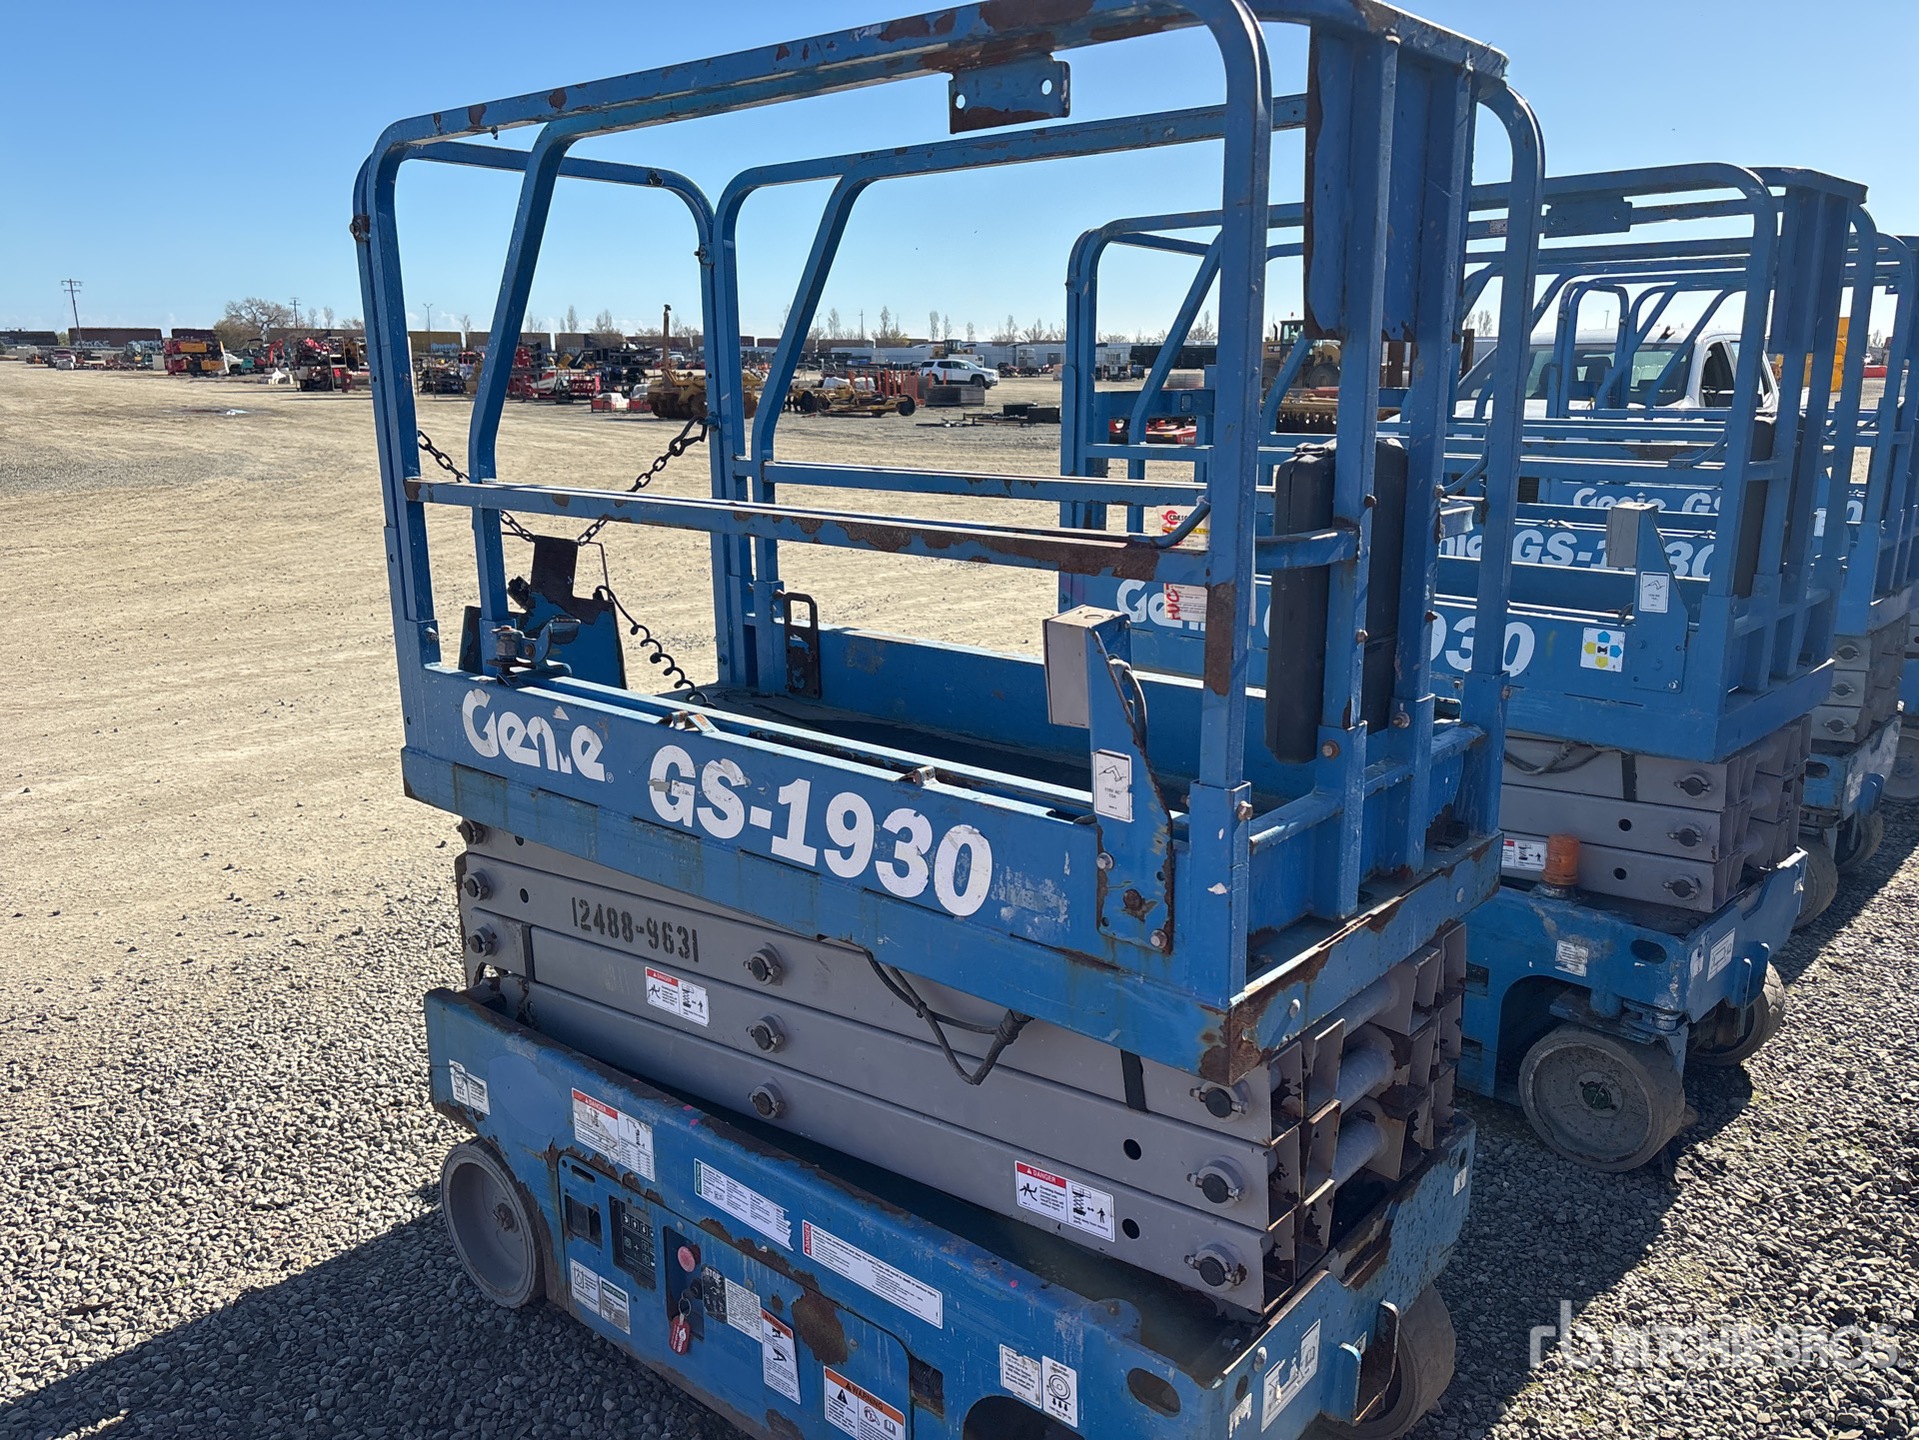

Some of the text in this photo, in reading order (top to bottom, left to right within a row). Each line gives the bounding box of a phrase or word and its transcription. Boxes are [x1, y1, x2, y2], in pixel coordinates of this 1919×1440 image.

[648, 744, 993, 917] GS-1930
[571, 896, 700, 963] 12488-9631
[1032, 1169, 1057, 1184] DANGER
